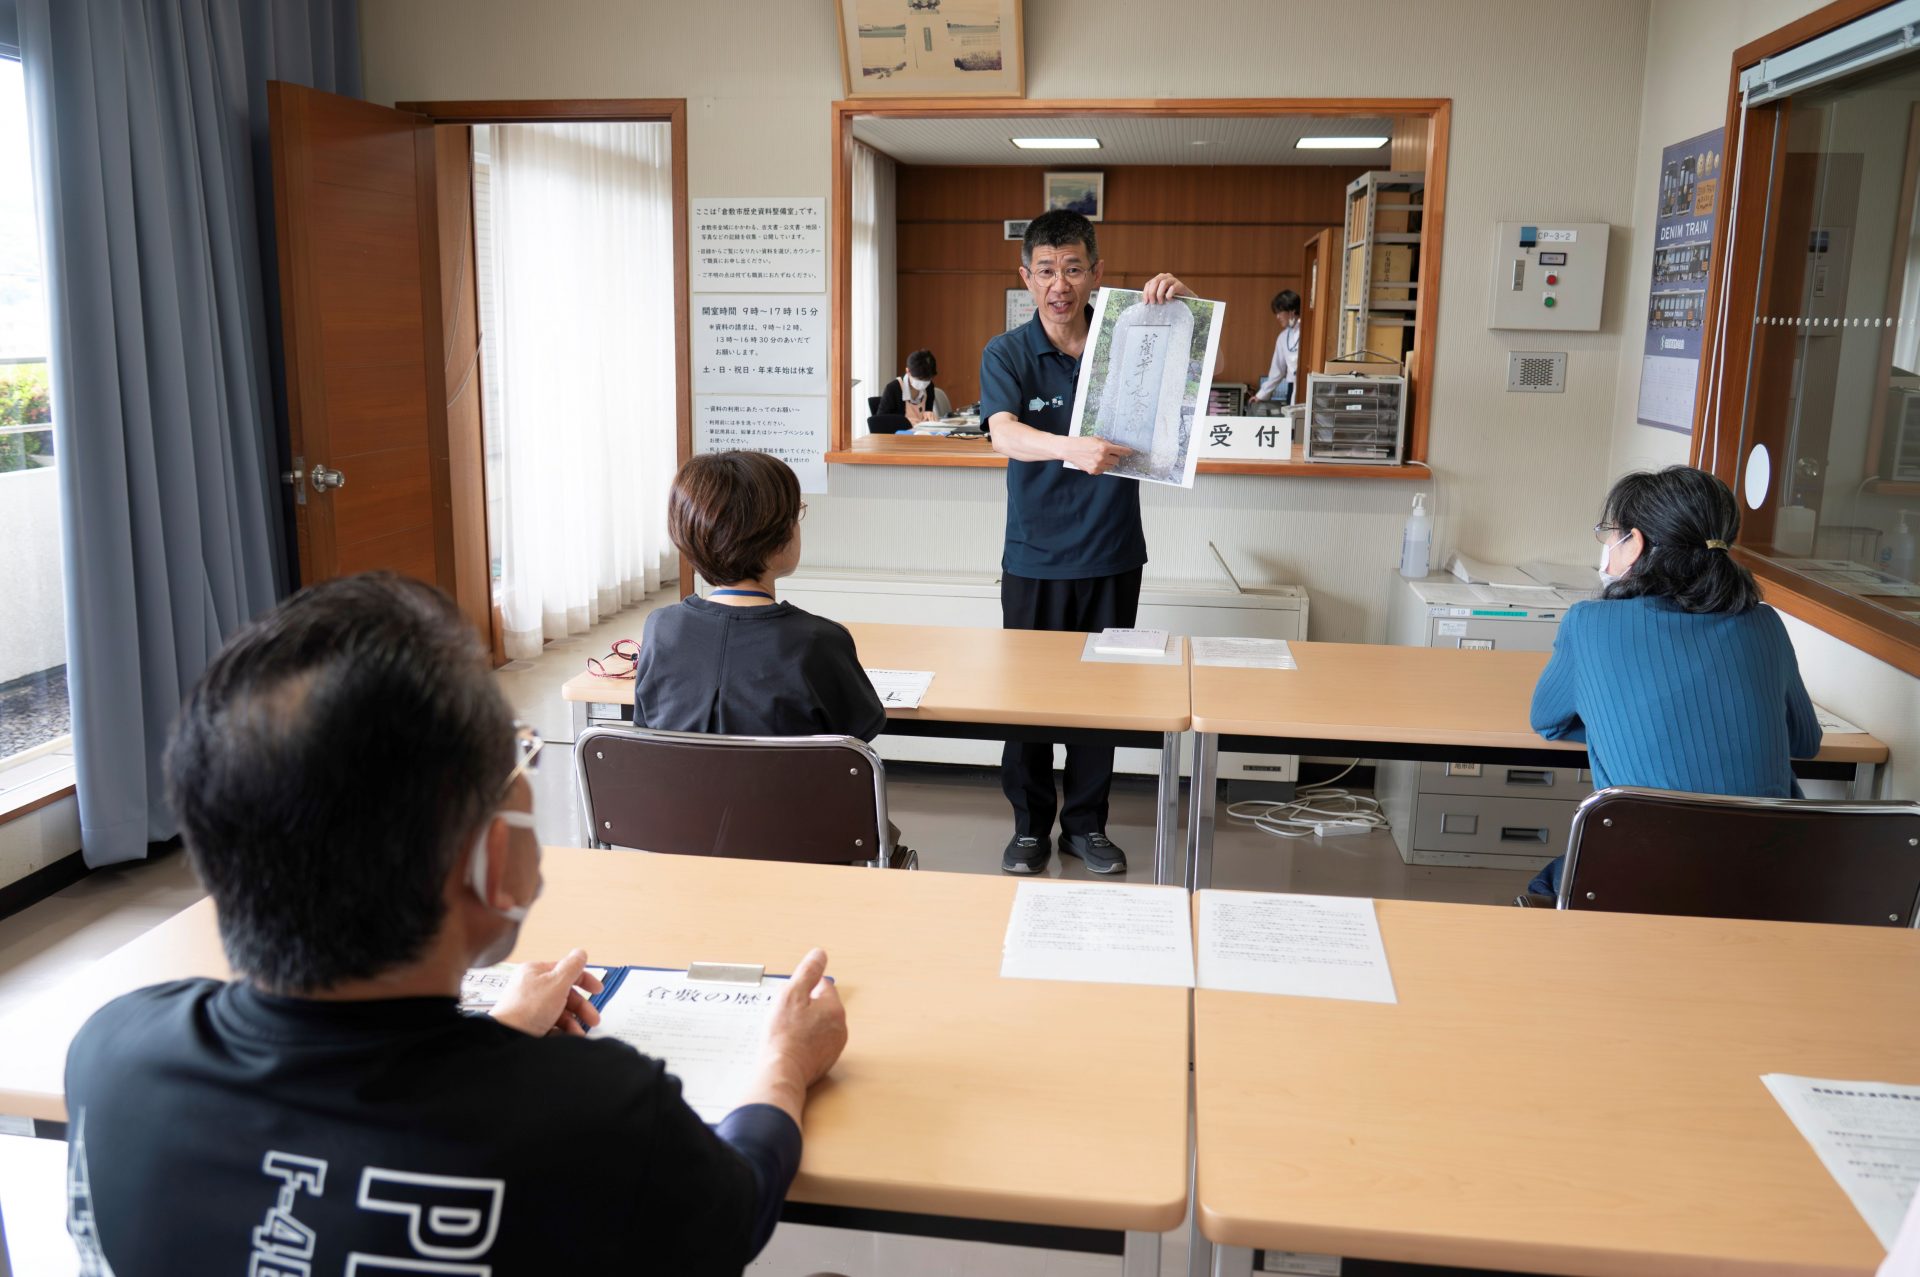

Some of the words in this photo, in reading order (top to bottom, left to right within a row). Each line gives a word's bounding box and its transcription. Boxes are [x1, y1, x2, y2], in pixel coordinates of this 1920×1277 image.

[696, 207, 817, 216] ここは「倉敷市歴史資料整備室」です。
[1660, 223, 1683, 241] DENIM
[1686, 219, 1709, 236] TRAIN
[702, 307, 737, 316] 開室時間
[1209, 423, 1280, 448] 受付
[644, 986, 772, 1006] 倉敷の歴
